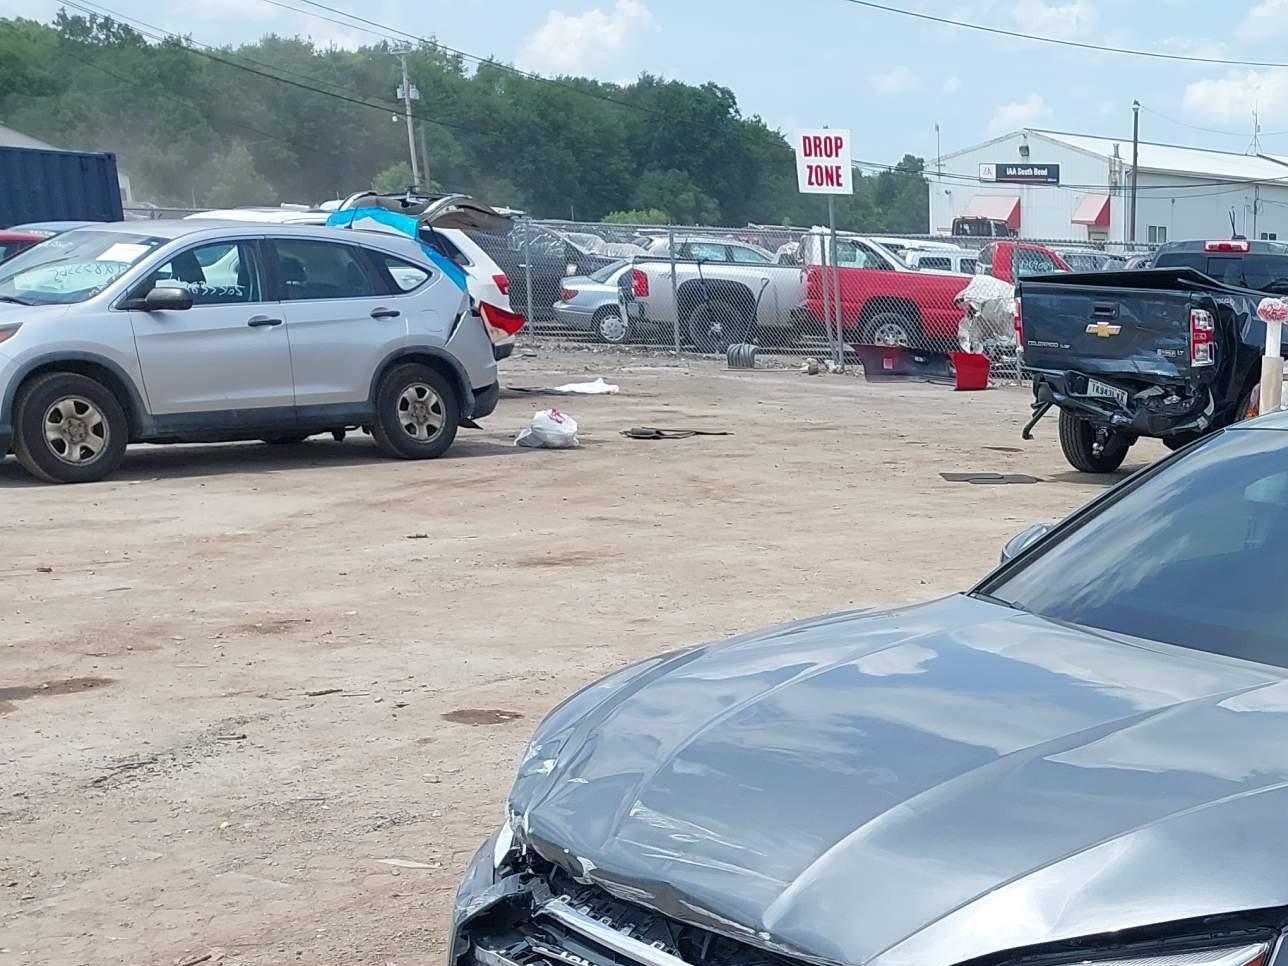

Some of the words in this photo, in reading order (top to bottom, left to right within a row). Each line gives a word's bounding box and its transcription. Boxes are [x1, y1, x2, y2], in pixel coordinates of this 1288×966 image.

[802, 135, 843, 158] DROP
[806, 164, 843, 187] ZONE
[1006, 167, 1016, 176] IAA
